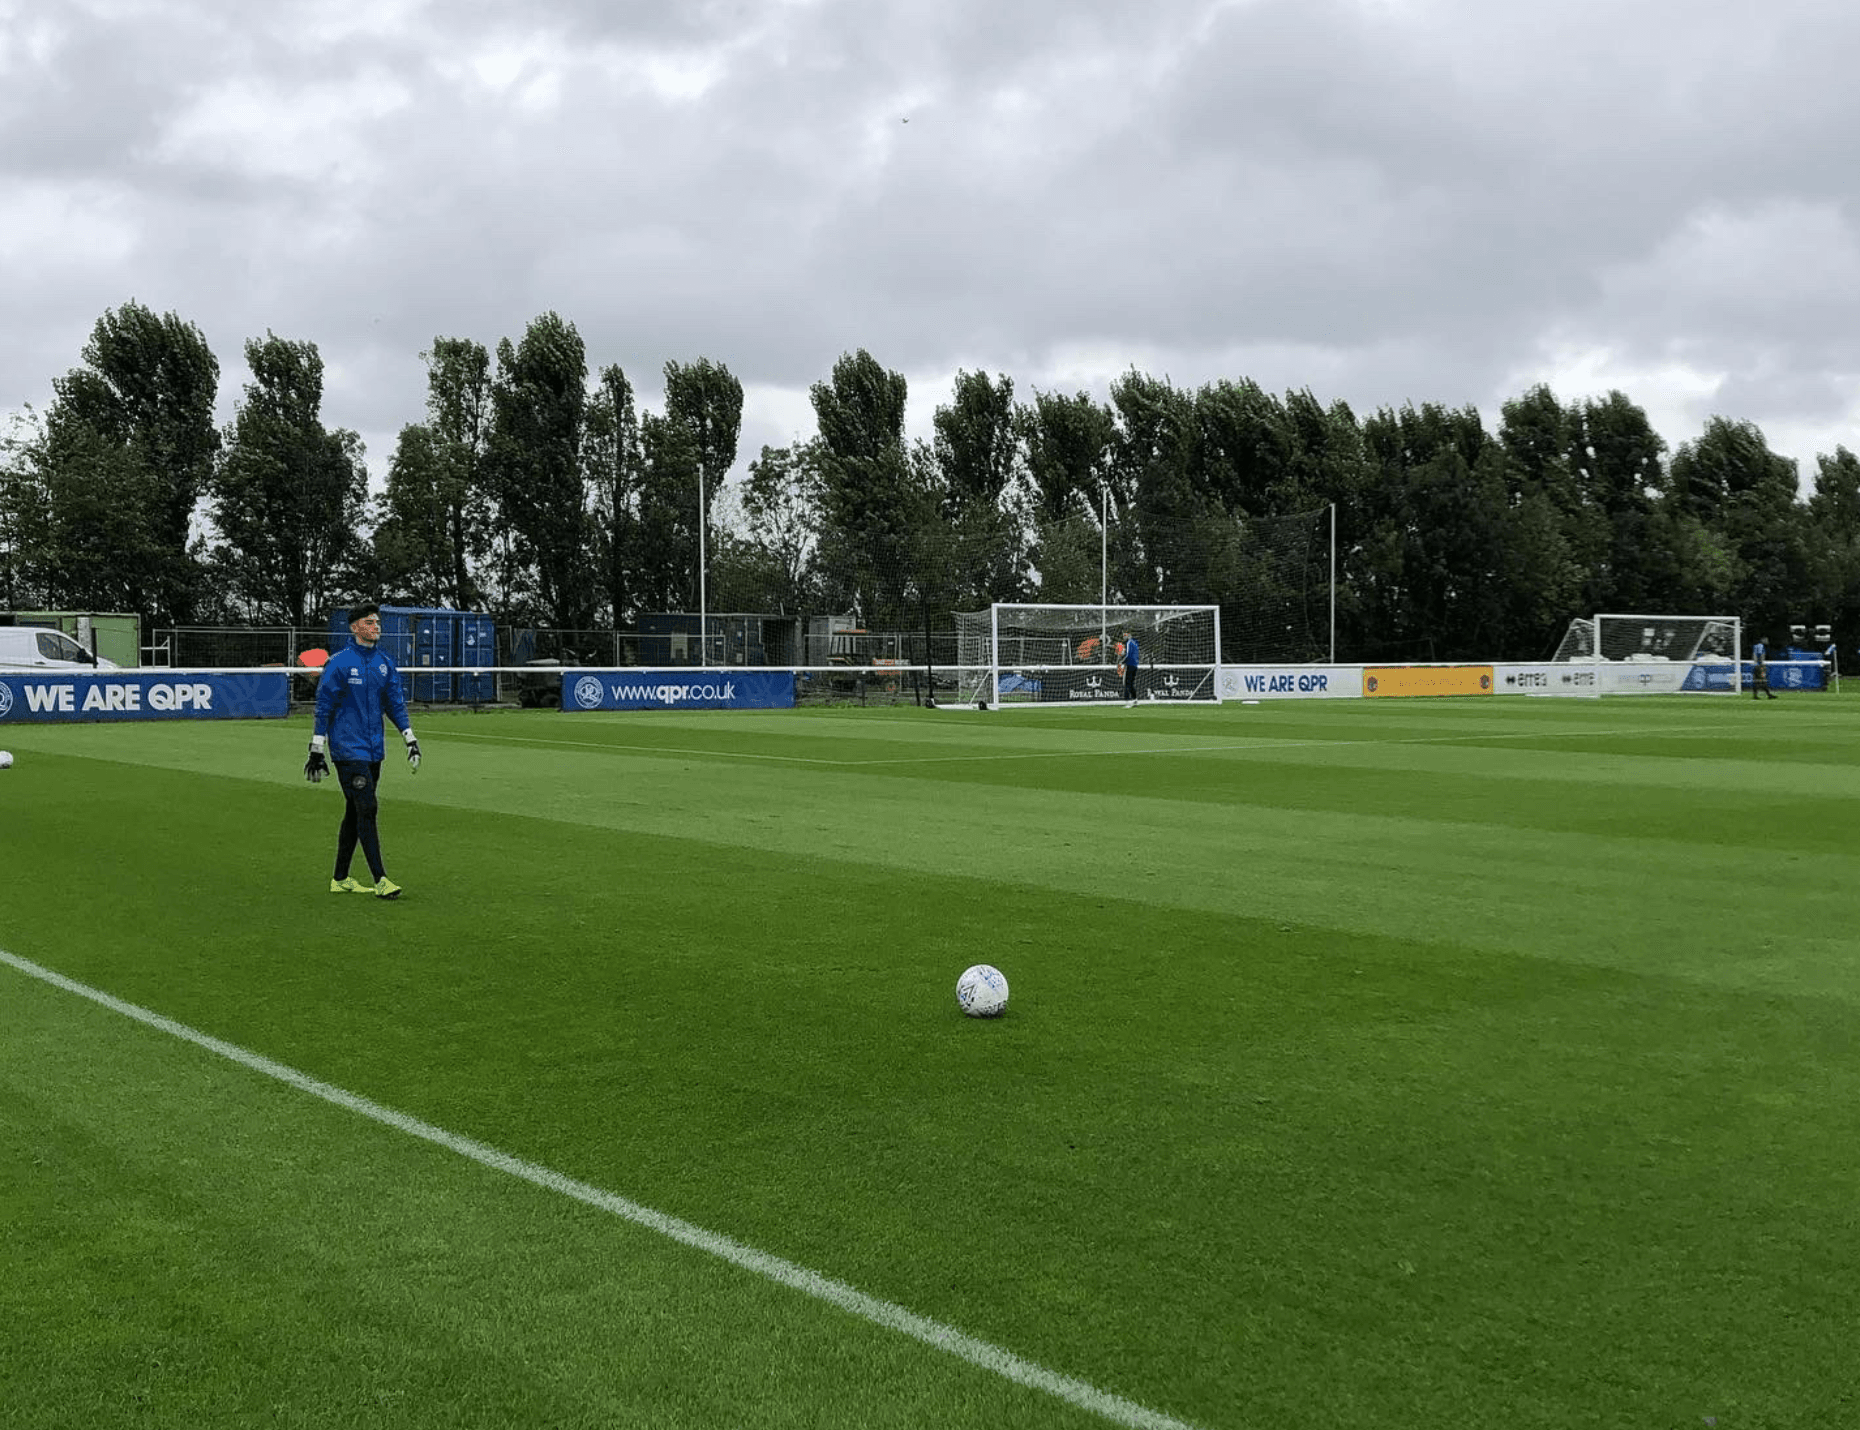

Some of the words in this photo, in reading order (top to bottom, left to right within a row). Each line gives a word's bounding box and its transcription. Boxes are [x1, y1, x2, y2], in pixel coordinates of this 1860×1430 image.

[612, 681, 736, 704] www.qpr.co.uk
[1069, 689, 1093, 698] ROYAL
[1094, 689, 1120, 698] PANDA
[1244, 675, 1265, 692] WE
[1268, 675, 1294, 692] ARE
[1298, 675, 1328, 692] QPR
[24, 684, 75, 712] WE
[82, 684, 141, 712] ARE
[148, 683, 212, 710] QPR
